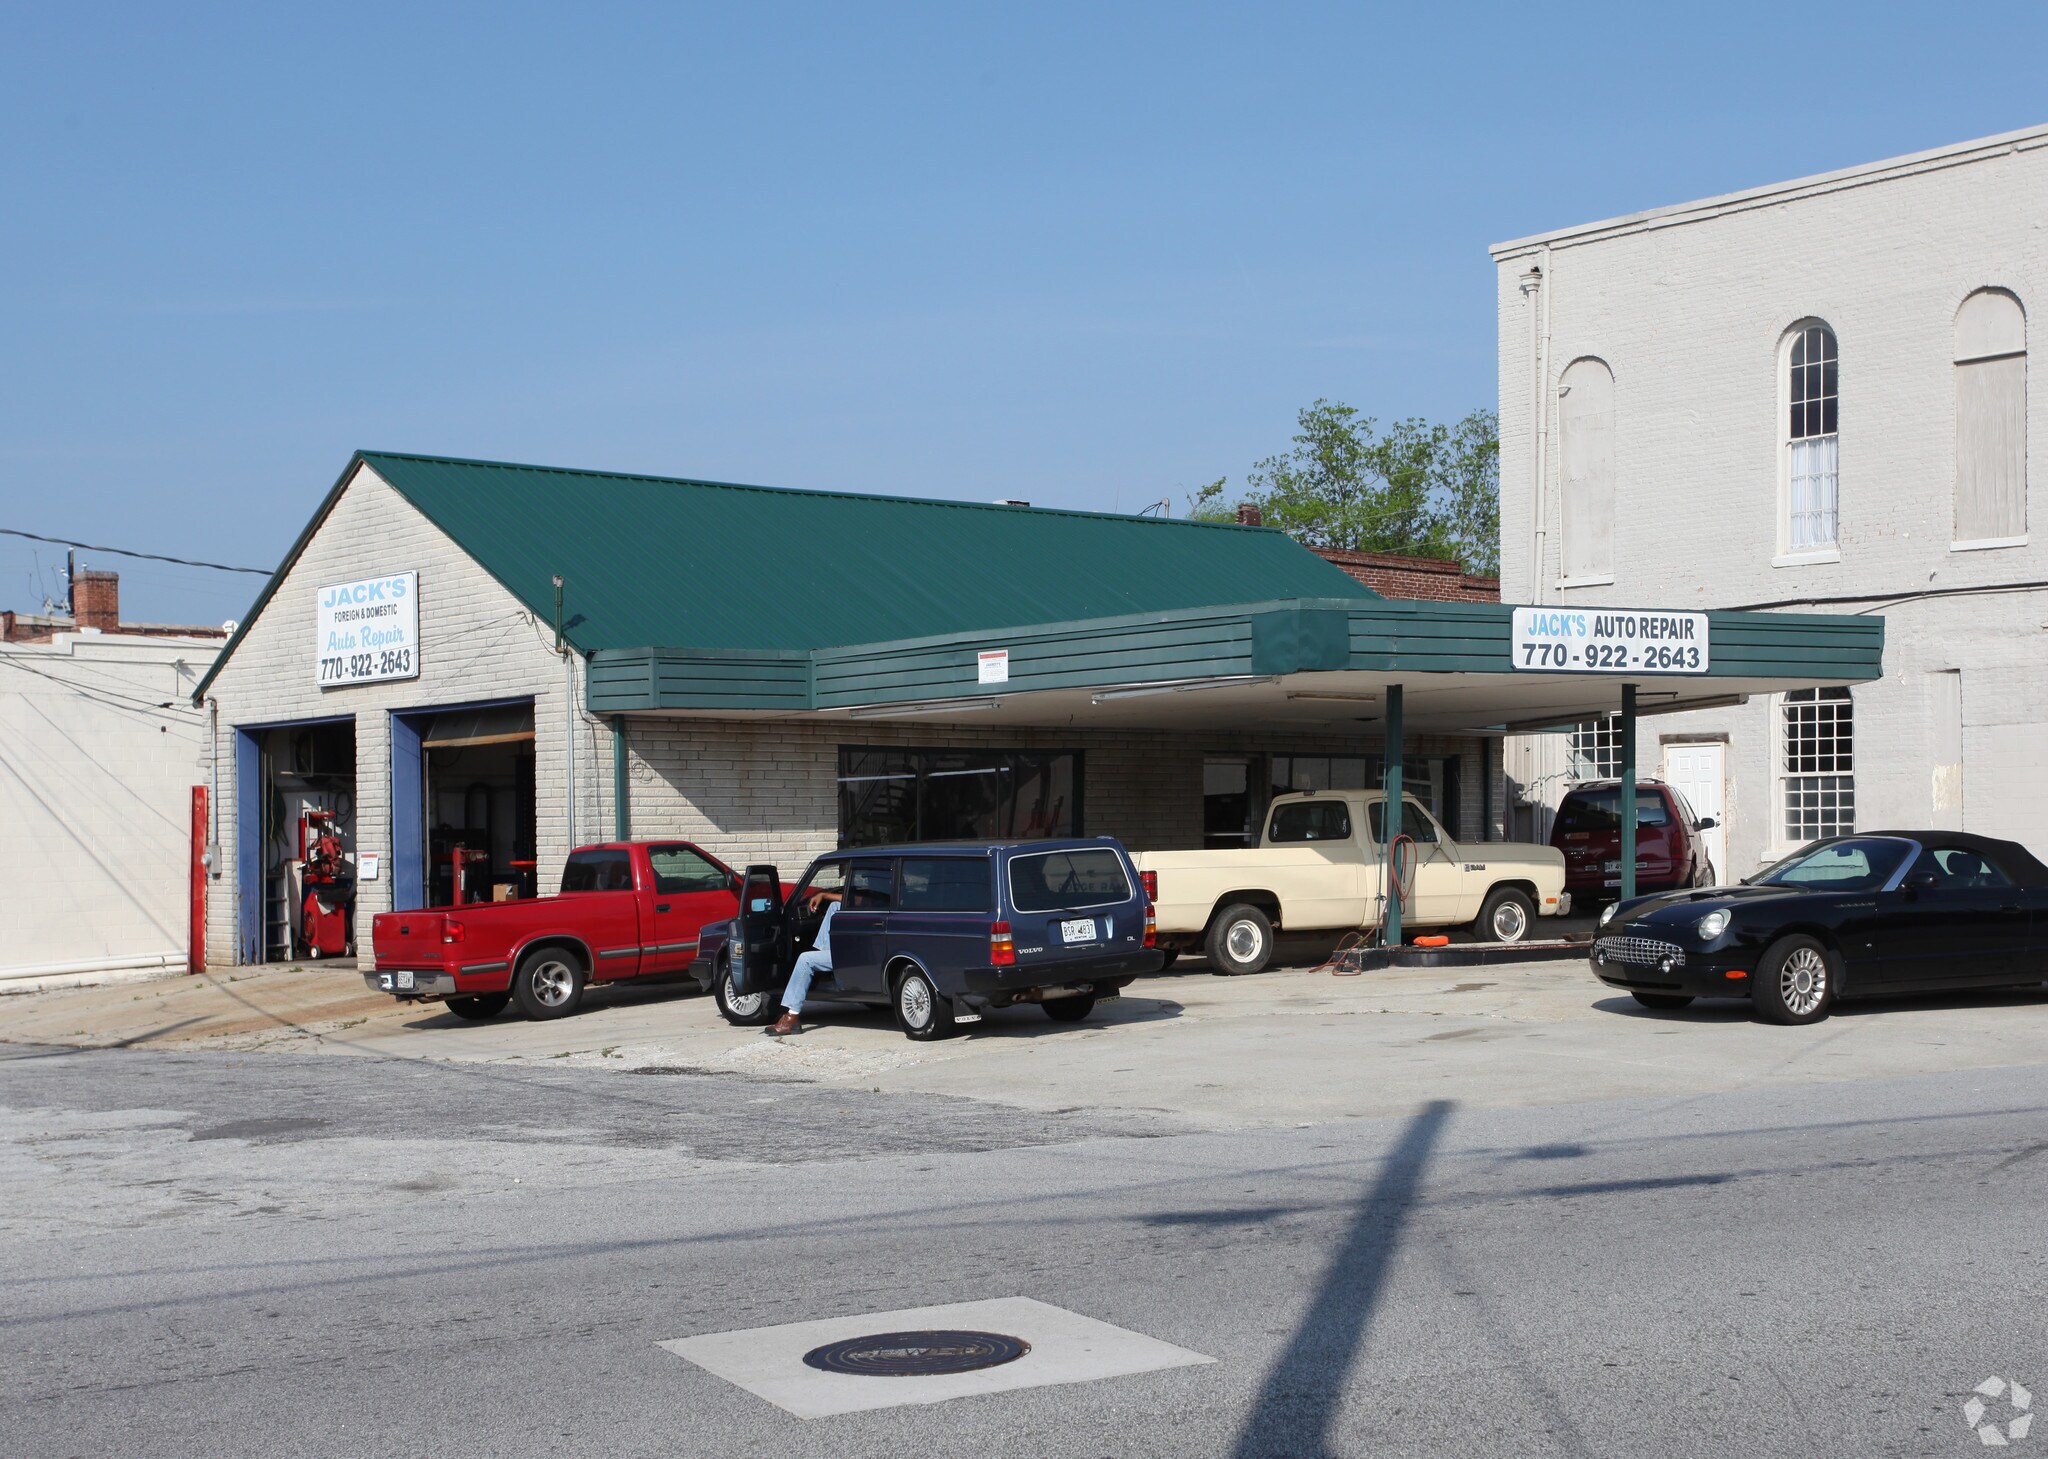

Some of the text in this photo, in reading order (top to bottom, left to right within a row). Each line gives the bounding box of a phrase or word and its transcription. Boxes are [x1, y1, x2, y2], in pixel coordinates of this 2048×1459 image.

[324, 578, 407, 608] JACK'S
[334, 603, 398, 623] FOREIGN & DOMESTIC
[1528, 613, 1695, 640] JACK'S AUTO REPAIR
[327, 624, 405, 652] Auto Repair
